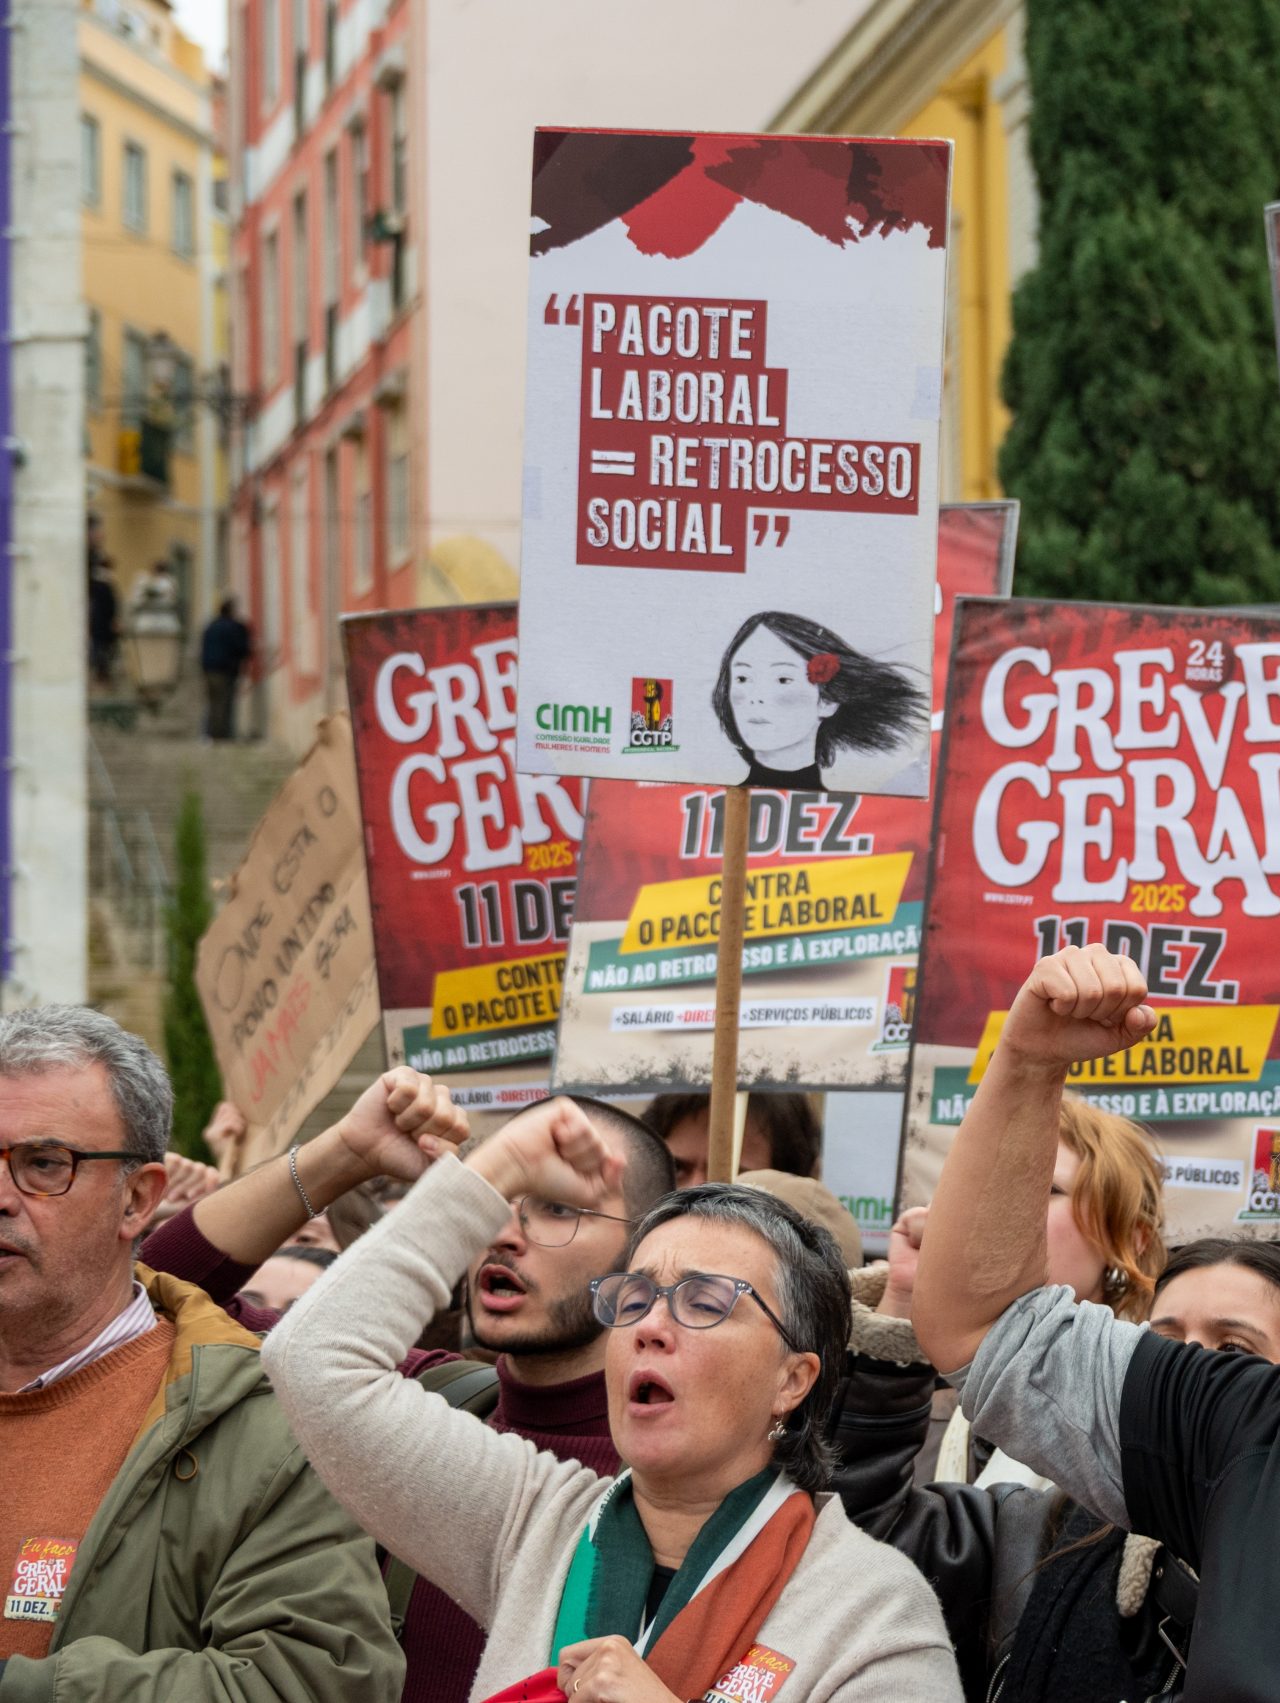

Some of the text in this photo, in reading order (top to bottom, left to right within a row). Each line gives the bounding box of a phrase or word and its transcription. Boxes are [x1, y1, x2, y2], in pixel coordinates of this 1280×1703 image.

[590, 367, 781, 428] LABORAL
[649, 436, 915, 499] RETROCESSO
[1186, 639, 1227, 669] 24
[1184, 665, 1223, 683] HORAS
[375, 636, 519, 760] GRE
[631, 730, 673, 746] CGTP
[745, 791, 876, 857] DEZ.
[527, 841, 574, 872] 2025
[708, 870, 811, 907] CNTRA
[1129, 883, 1187, 913] 2025
[454, 876, 578, 949] 11 DE
[639, 892, 884, 946] O PACOE LABORAL
[590, 925, 920, 990] NÃO AO RETROSSO E À EXPLORAÇÃ
[443, 1004, 458, 1031] O
[461, 990, 546, 1028] PACOTE
[615, 1003, 873, 1026] +SALÁRIO +DIREI +SERVIÇOS PÚBLICOS
[409, 1029, 557, 1072] NÃO AO RETROCESS
[1124, 1046, 1249, 1077] LABORAL
[937, 1094, 973, 1120] NÃ
[1139, 1090, 1151, 1115] E
[1154, 1087, 1169, 1115] À
[1176, 1161, 1241, 1186] PÚBLICOS
[17, 1558, 67, 1579] GREVE
[14, 1574, 67, 1597] GERAL
[11, 1600, 50, 1615] 11 DEZ.
